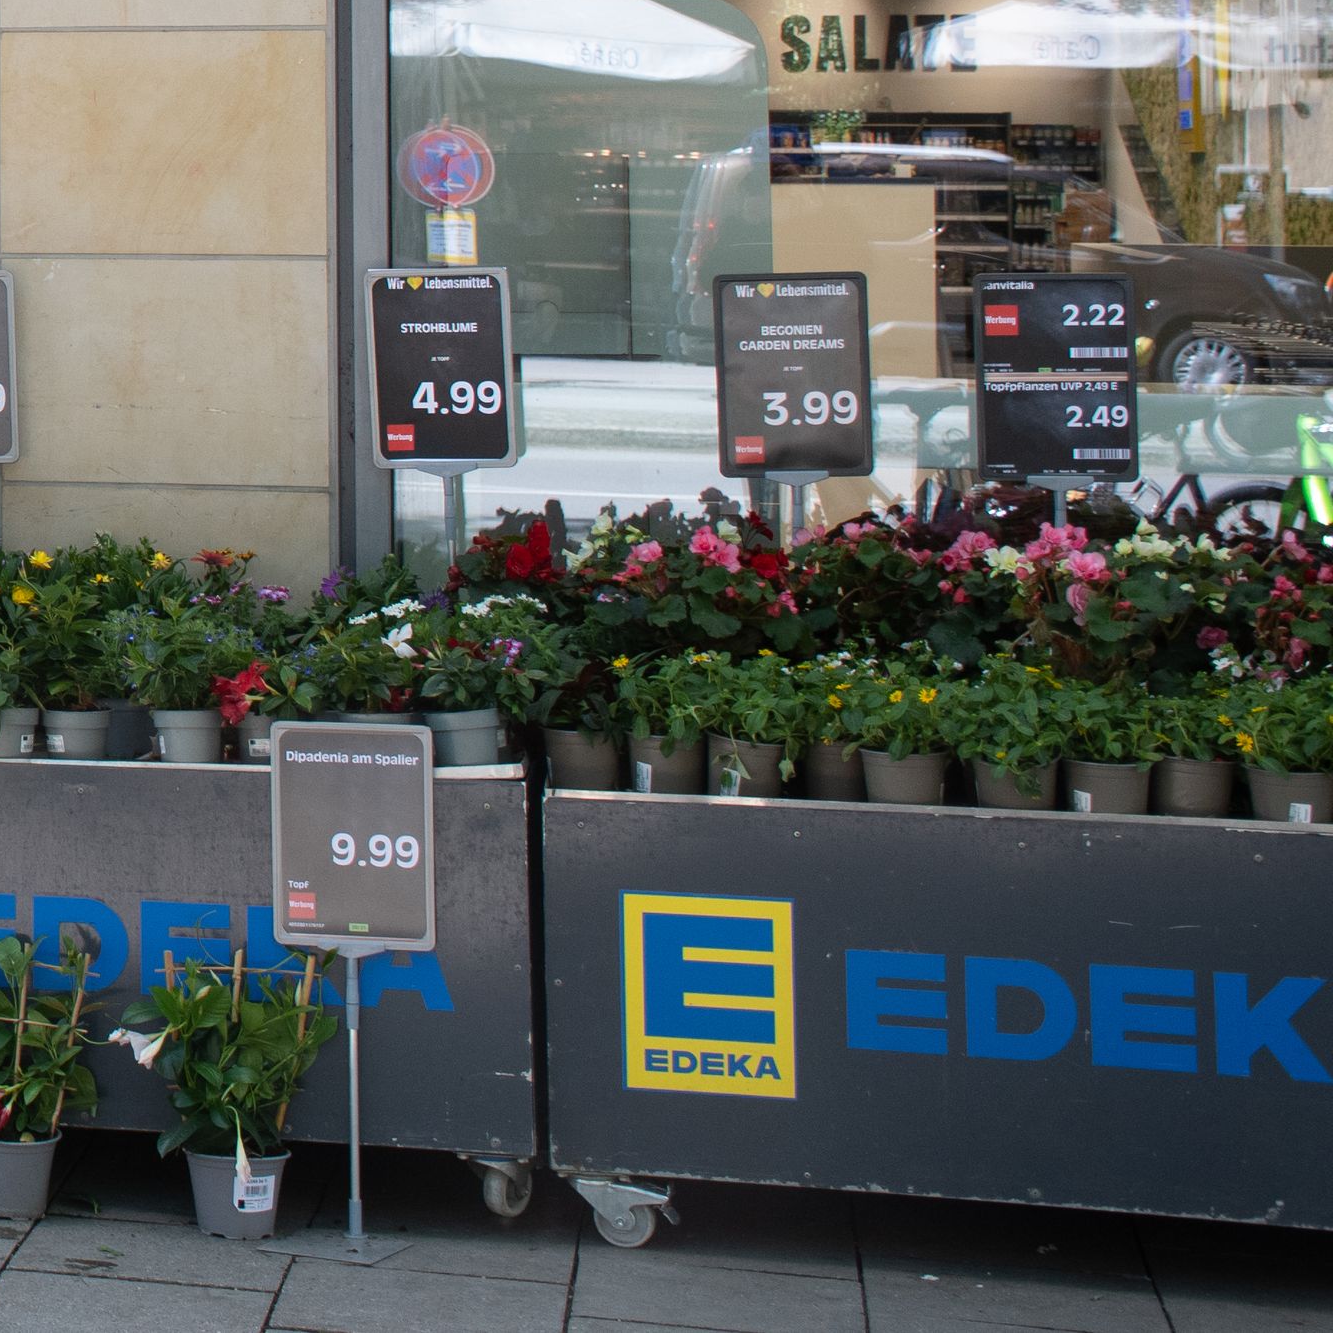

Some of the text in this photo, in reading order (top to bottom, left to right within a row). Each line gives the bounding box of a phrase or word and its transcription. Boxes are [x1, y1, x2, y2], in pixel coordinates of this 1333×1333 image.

[781, 14, 978, 72] SALATE
[387, 276, 493, 290] Wir Lebensmittel.
[983, 281, 1034, 290] anvitalia
[735, 284, 849, 297] Wir Lebensmittel.
[985, 304, 1125, 326] Werbung 2.22
[401, 323, 477, 333] STROHBLUME
[761, 325, 822, 336] BEGONIEN
[739, 339, 845, 351] GARDEN DREAMS
[984, 382, 1058, 392] Topfpflanzen
[1061, 382, 1082, 390] UVP
[1085, 382, 1107, 391] 2,49
[412, 381, 501, 414] 4.99
[763, 391, 858, 425] 3.99
[1065, 406, 1129, 428] 2.49
[388, 434, 413, 442] Werbung
[735, 445, 763, 454] Werbung
[286, 751, 419, 766] Dipadenia am Spalier
[331, 833, 419, 868] 9.99
[288, 880, 309, 889] Topf
[289, 901, 314, 910] Werbung
[644, 1049, 781, 1081] EDEKA
